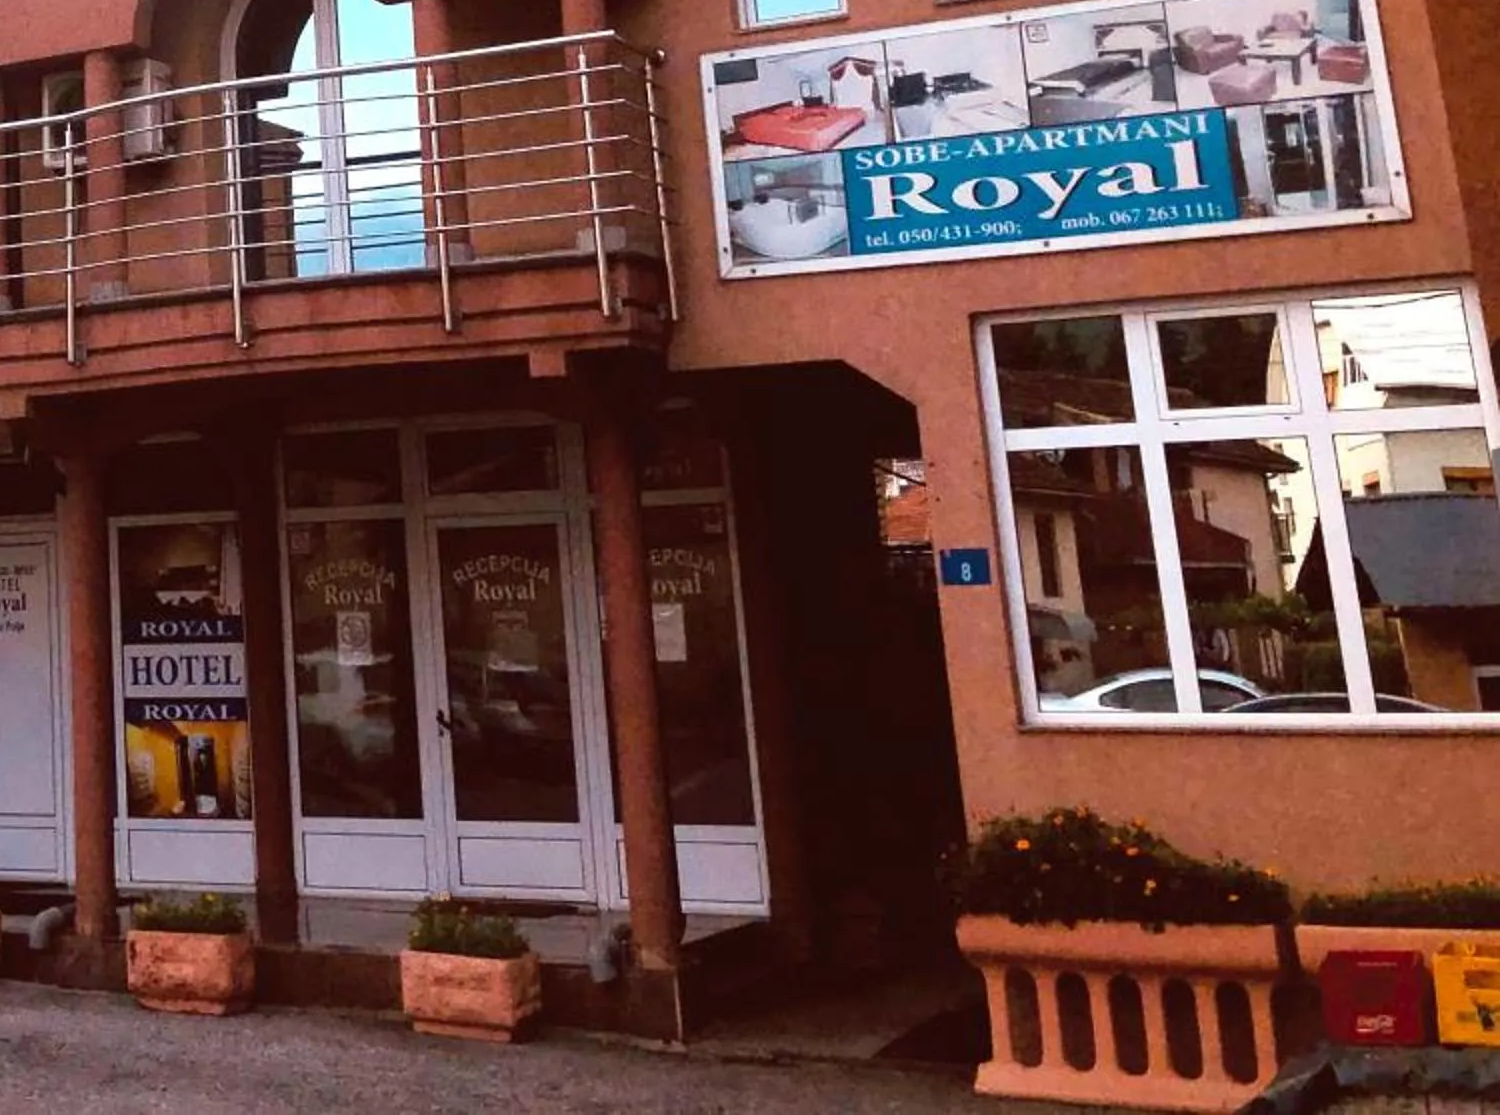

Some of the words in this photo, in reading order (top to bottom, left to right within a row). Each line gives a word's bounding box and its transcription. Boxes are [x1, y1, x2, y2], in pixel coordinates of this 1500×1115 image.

[854, 112, 1211, 171] SOBE-APARTMANI
[863, 140, 1210, 221] Royal
[865, 233, 895, 249] tel.
[1060, 213, 1106, 232] mob.
[1108, 210, 1142, 228] 067
[1146, 206, 1181, 224] 263
[452, 554, 551, 584] RECEPCIJA
[961, 561, 972, 582] 8
[324, 584, 384, 613] Royal
[473, 579, 537, 607] Royal
[651, 573, 705, 601] oyal
[140, 620, 232, 638] ROYAL
[130, 654, 243, 687] HOTEL
[143, 704, 236, 722] ROYAL
